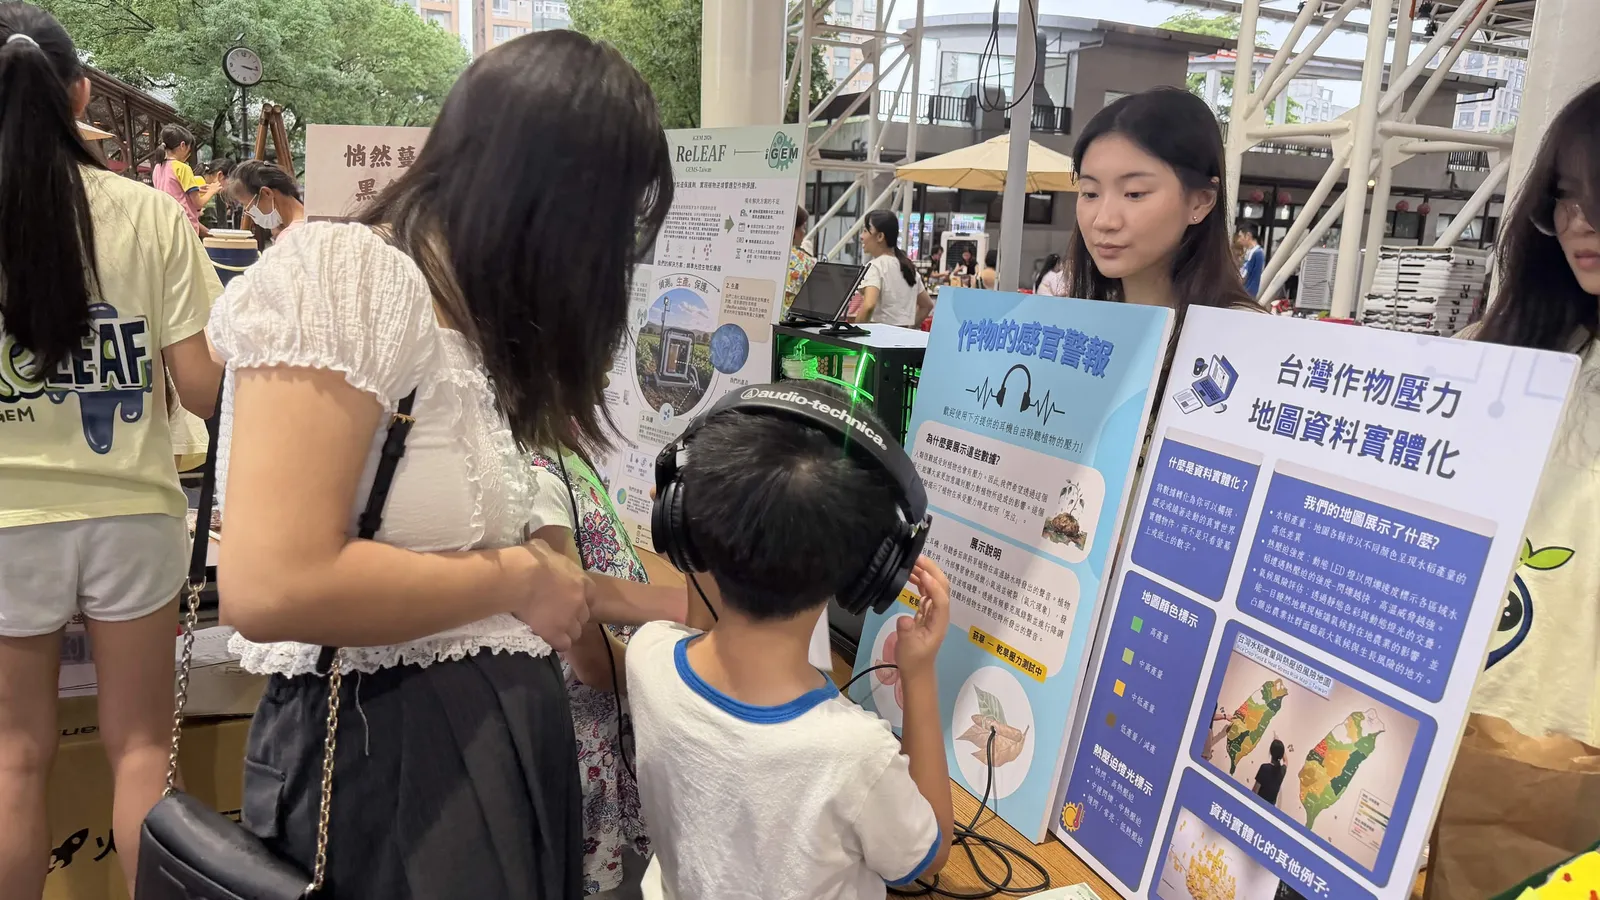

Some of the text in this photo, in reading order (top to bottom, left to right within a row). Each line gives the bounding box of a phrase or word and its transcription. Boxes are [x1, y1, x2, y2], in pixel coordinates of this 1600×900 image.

[676, 144, 727, 163] ReLEAF
[765, 147, 798, 160] iGEM
[958, 318, 1114, 379] 作物的感官警報
[1277, 353, 1462, 419] 台灣作物壓力
[925, 432, 1001, 466] 為什麼要展示這些數據?
[1248, 397, 1460, 480] 地圖資料實體化
[1168, 456, 1248, 492] 什麼是資料實體化？
[1271, 524, 1303, 544] 高低差異
[1303, 494, 1440, 551] 我們的地圖展示了什麼?
[969, 536, 1003, 561] 展示說明
[1329, 562, 1346, 577] LED
[1141, 589, 1199, 629] 地圖顏色標示
[1149, 626, 1170, 644] 高產量
[995, 643, 1043, 677] 乾旱壓力測試中
[1138, 659, 1165, 681] 中高產量
[1131, 692, 1157, 715] 中低產量
[1092, 743, 1154, 797] 熱壓迫燈光標示
